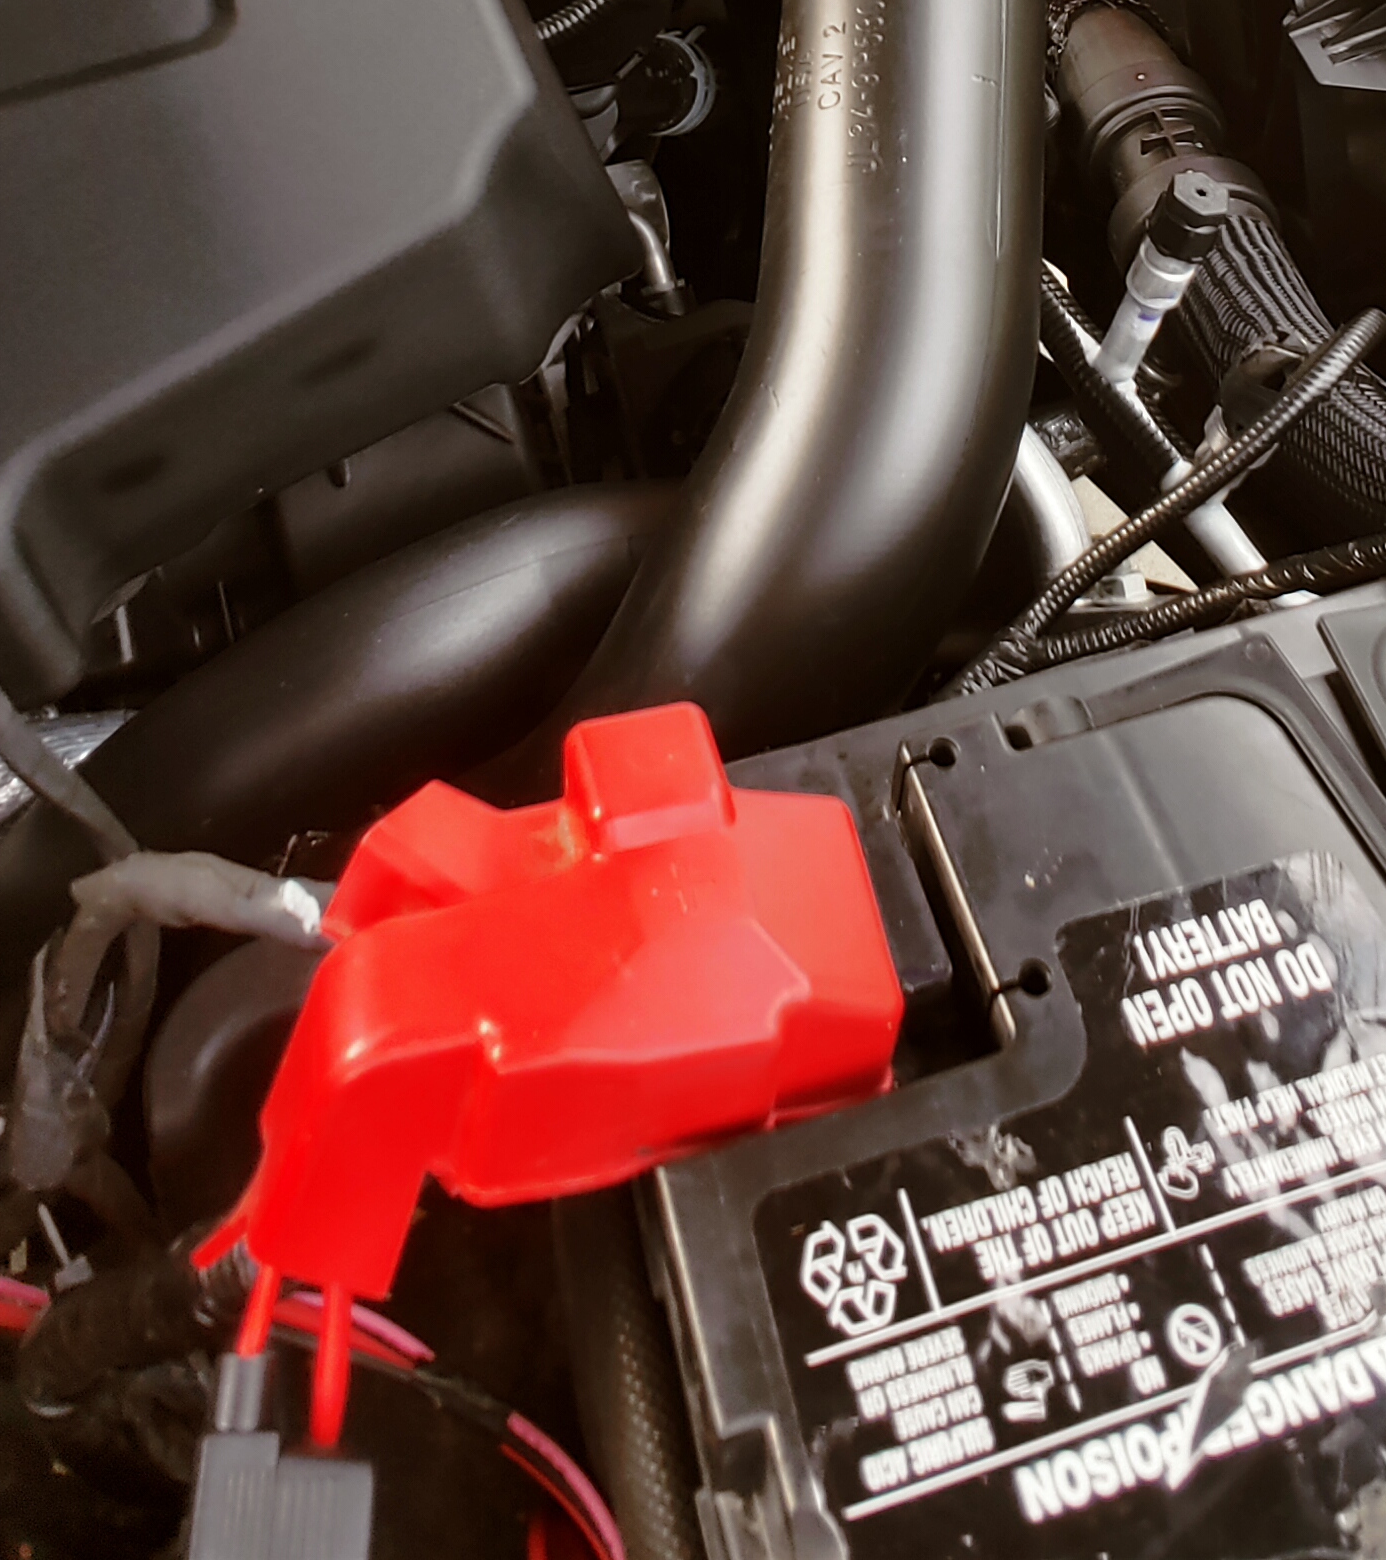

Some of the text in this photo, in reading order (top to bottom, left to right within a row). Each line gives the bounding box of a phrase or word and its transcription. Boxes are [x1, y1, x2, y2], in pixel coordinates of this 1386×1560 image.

[817, 21, 846, 111] CAV 2
[1137, 899, 1281, 981] BATTERY!
[1120, 940, 1333, 1049] DO NOT OPEN
[1251, 1082, 1303, 1123] HELP
[918, 1149, 1141, 1256] REACH OF CHILDREN.
[970, 1187, 1157, 1282] KEEP OUT OF THE
[1051, 1271, 1121, 1320] SMOKING
[1064, 1299, 1132, 1348] FLAMES
[1259, 1263, 1327, 1318] GASES
[844, 1324, 966, 1392] SEVERE BURNS
[1075, 1328, 1142, 1378] SPARKS
[1127, 1353, 1167, 1395] NO
[856, 1353, 975, 1422] BLINDNESS OR
[890, 1383, 984, 1443] CAN CAUSE
[857, 1414, 996, 1494] SULFURIC ACID
